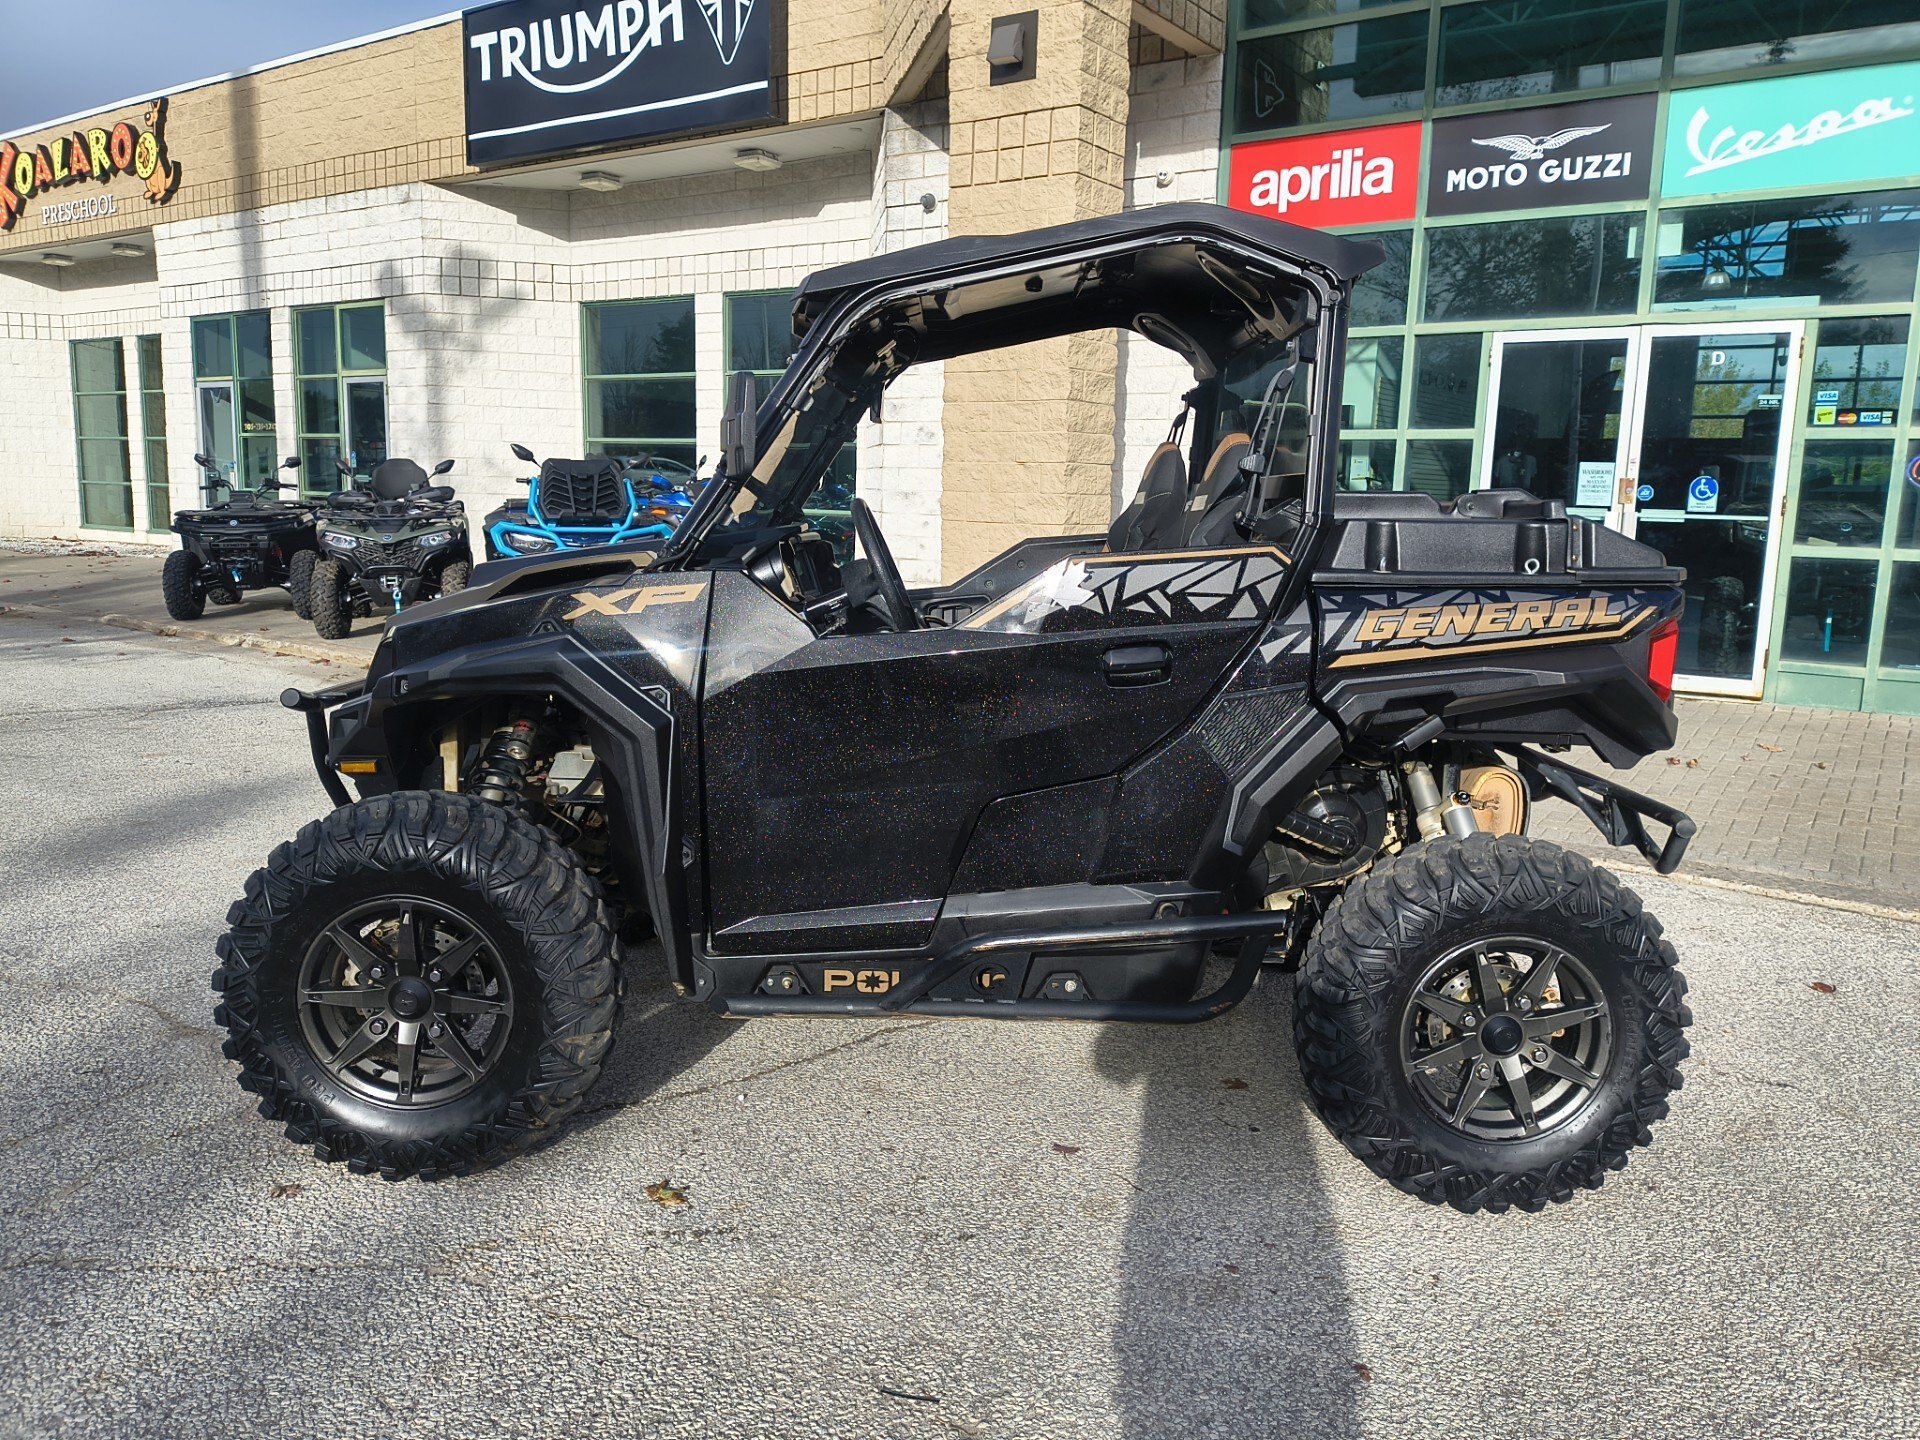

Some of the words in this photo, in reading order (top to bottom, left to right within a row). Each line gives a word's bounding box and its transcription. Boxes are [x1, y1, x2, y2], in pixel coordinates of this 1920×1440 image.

[471, 0, 684, 94] TRIUMPH
[1684, 96, 1914, 178] Vespa
[0, 122, 160, 231] KOALAROO
[1249, 147, 1394, 213] aprilia
[1446, 162, 1528, 193] MOTO
[1538, 152, 1632, 184] GUZZI
[41, 194, 119, 226] PRESCHOOL
[1710, 350, 1726, 366] D
[1862, 413, 1881, 421] VISA
[562, 582, 707, 620] XP
[1354, 596, 1626, 643] GENERAL
